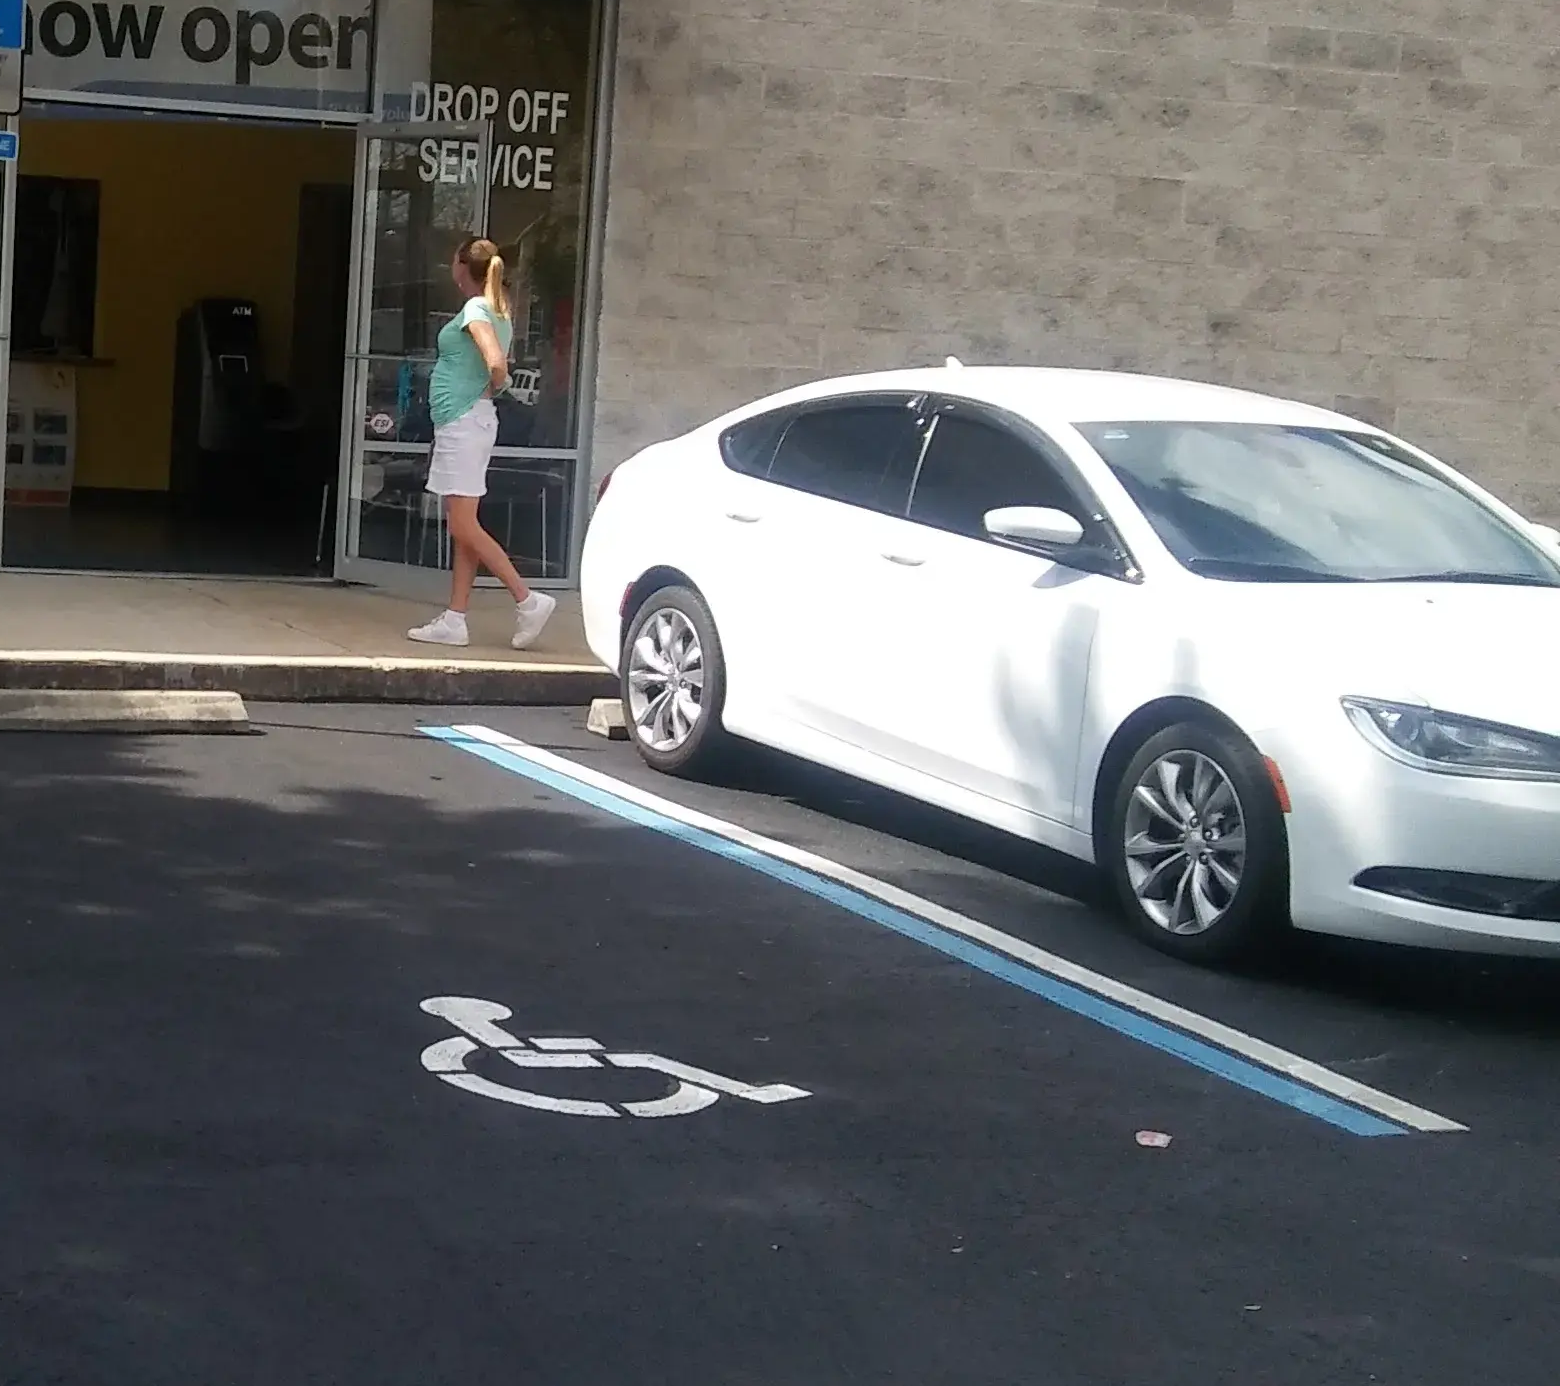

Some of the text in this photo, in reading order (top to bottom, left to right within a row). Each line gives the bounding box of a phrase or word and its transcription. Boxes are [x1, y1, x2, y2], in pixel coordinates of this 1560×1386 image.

[410, 81, 500, 123] DROP
[507, 88, 570, 135] OFF
[417, 138, 555, 191] SERVICE
[233, 307, 252, 316] ATM
